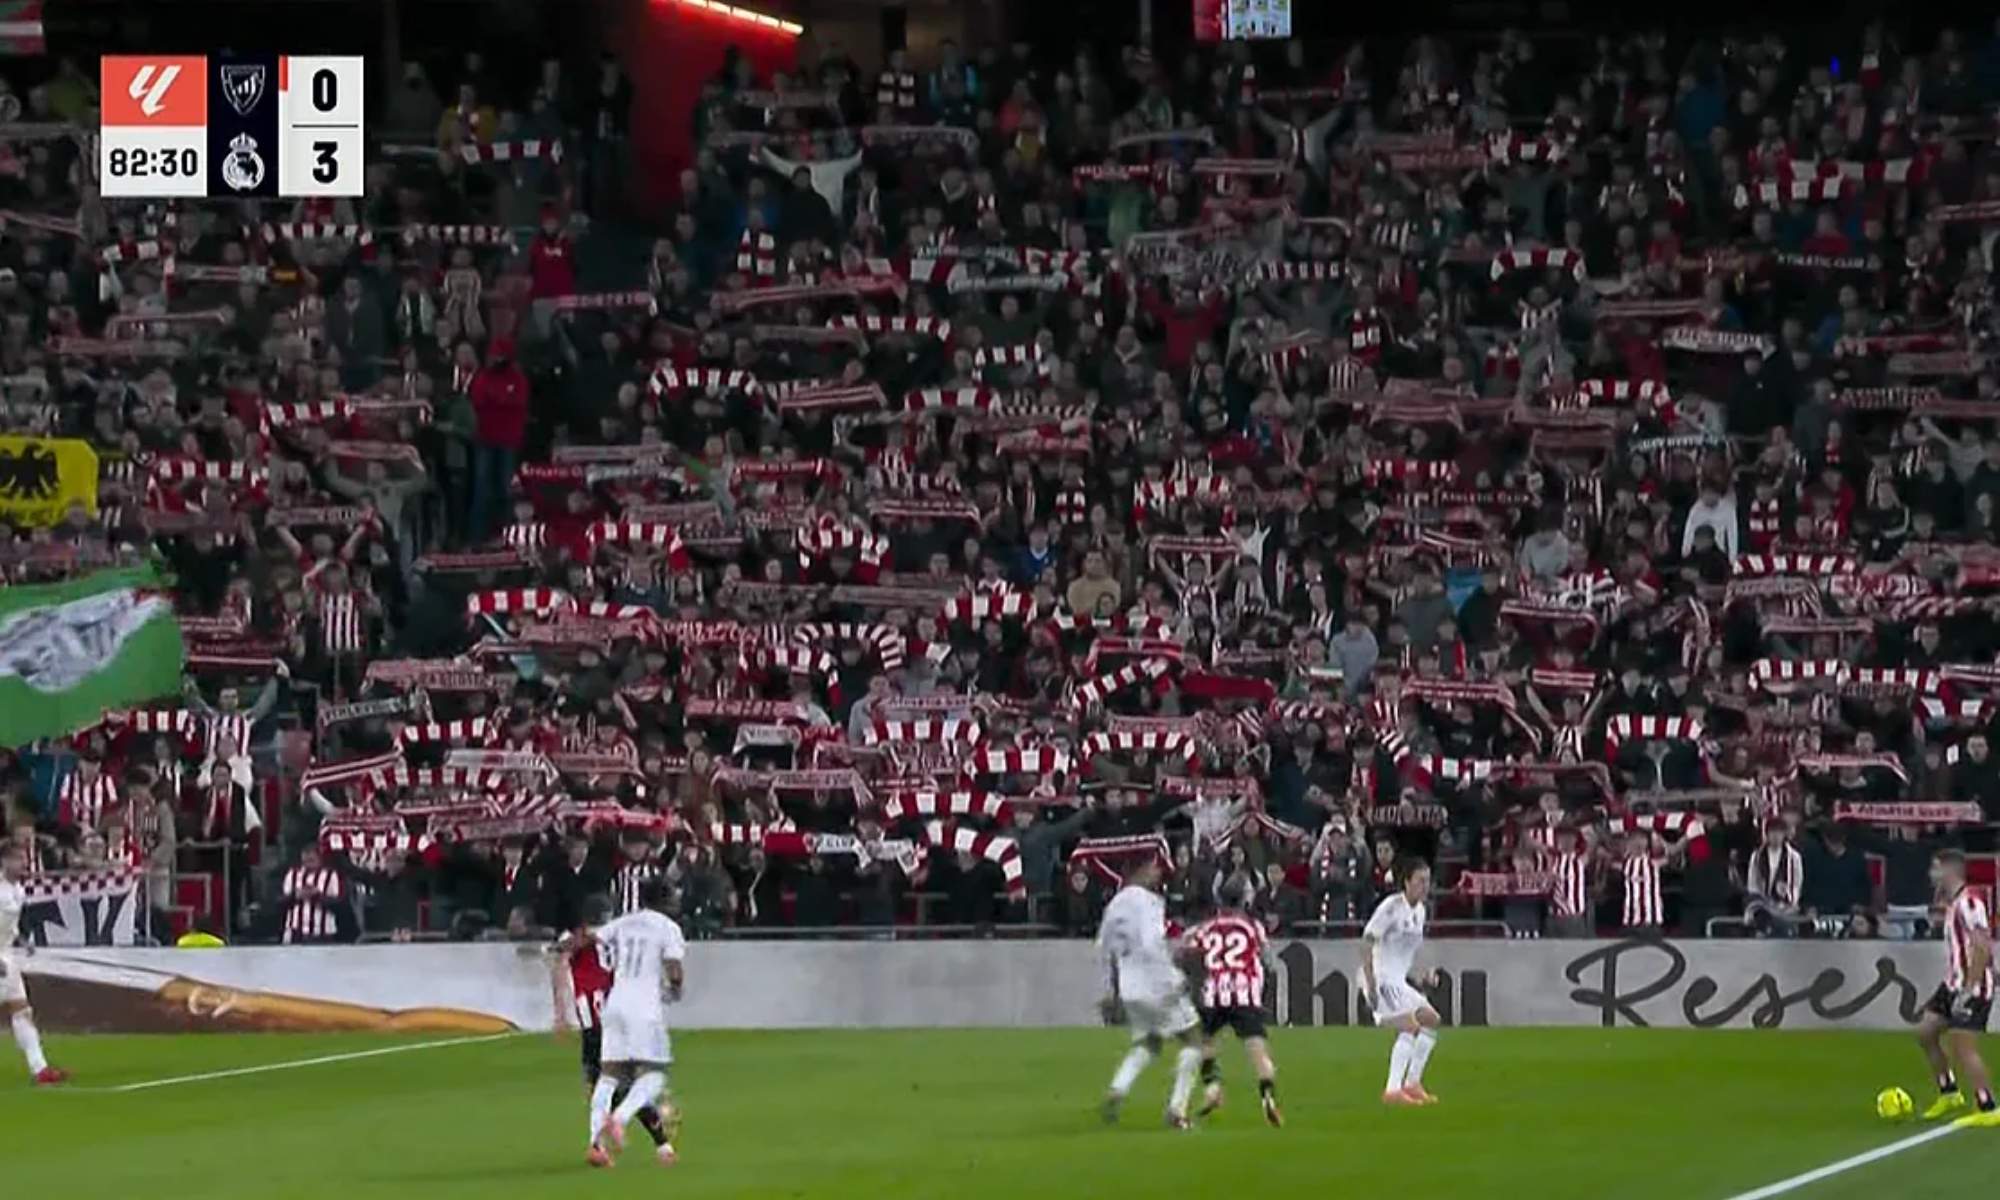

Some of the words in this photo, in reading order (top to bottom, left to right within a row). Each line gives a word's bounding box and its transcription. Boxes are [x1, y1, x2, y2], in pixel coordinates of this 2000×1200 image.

[625, 936, 649, 979] 11
[1203, 930, 1250, 970] 22
[1565, 935, 1926, 1027] Reser
